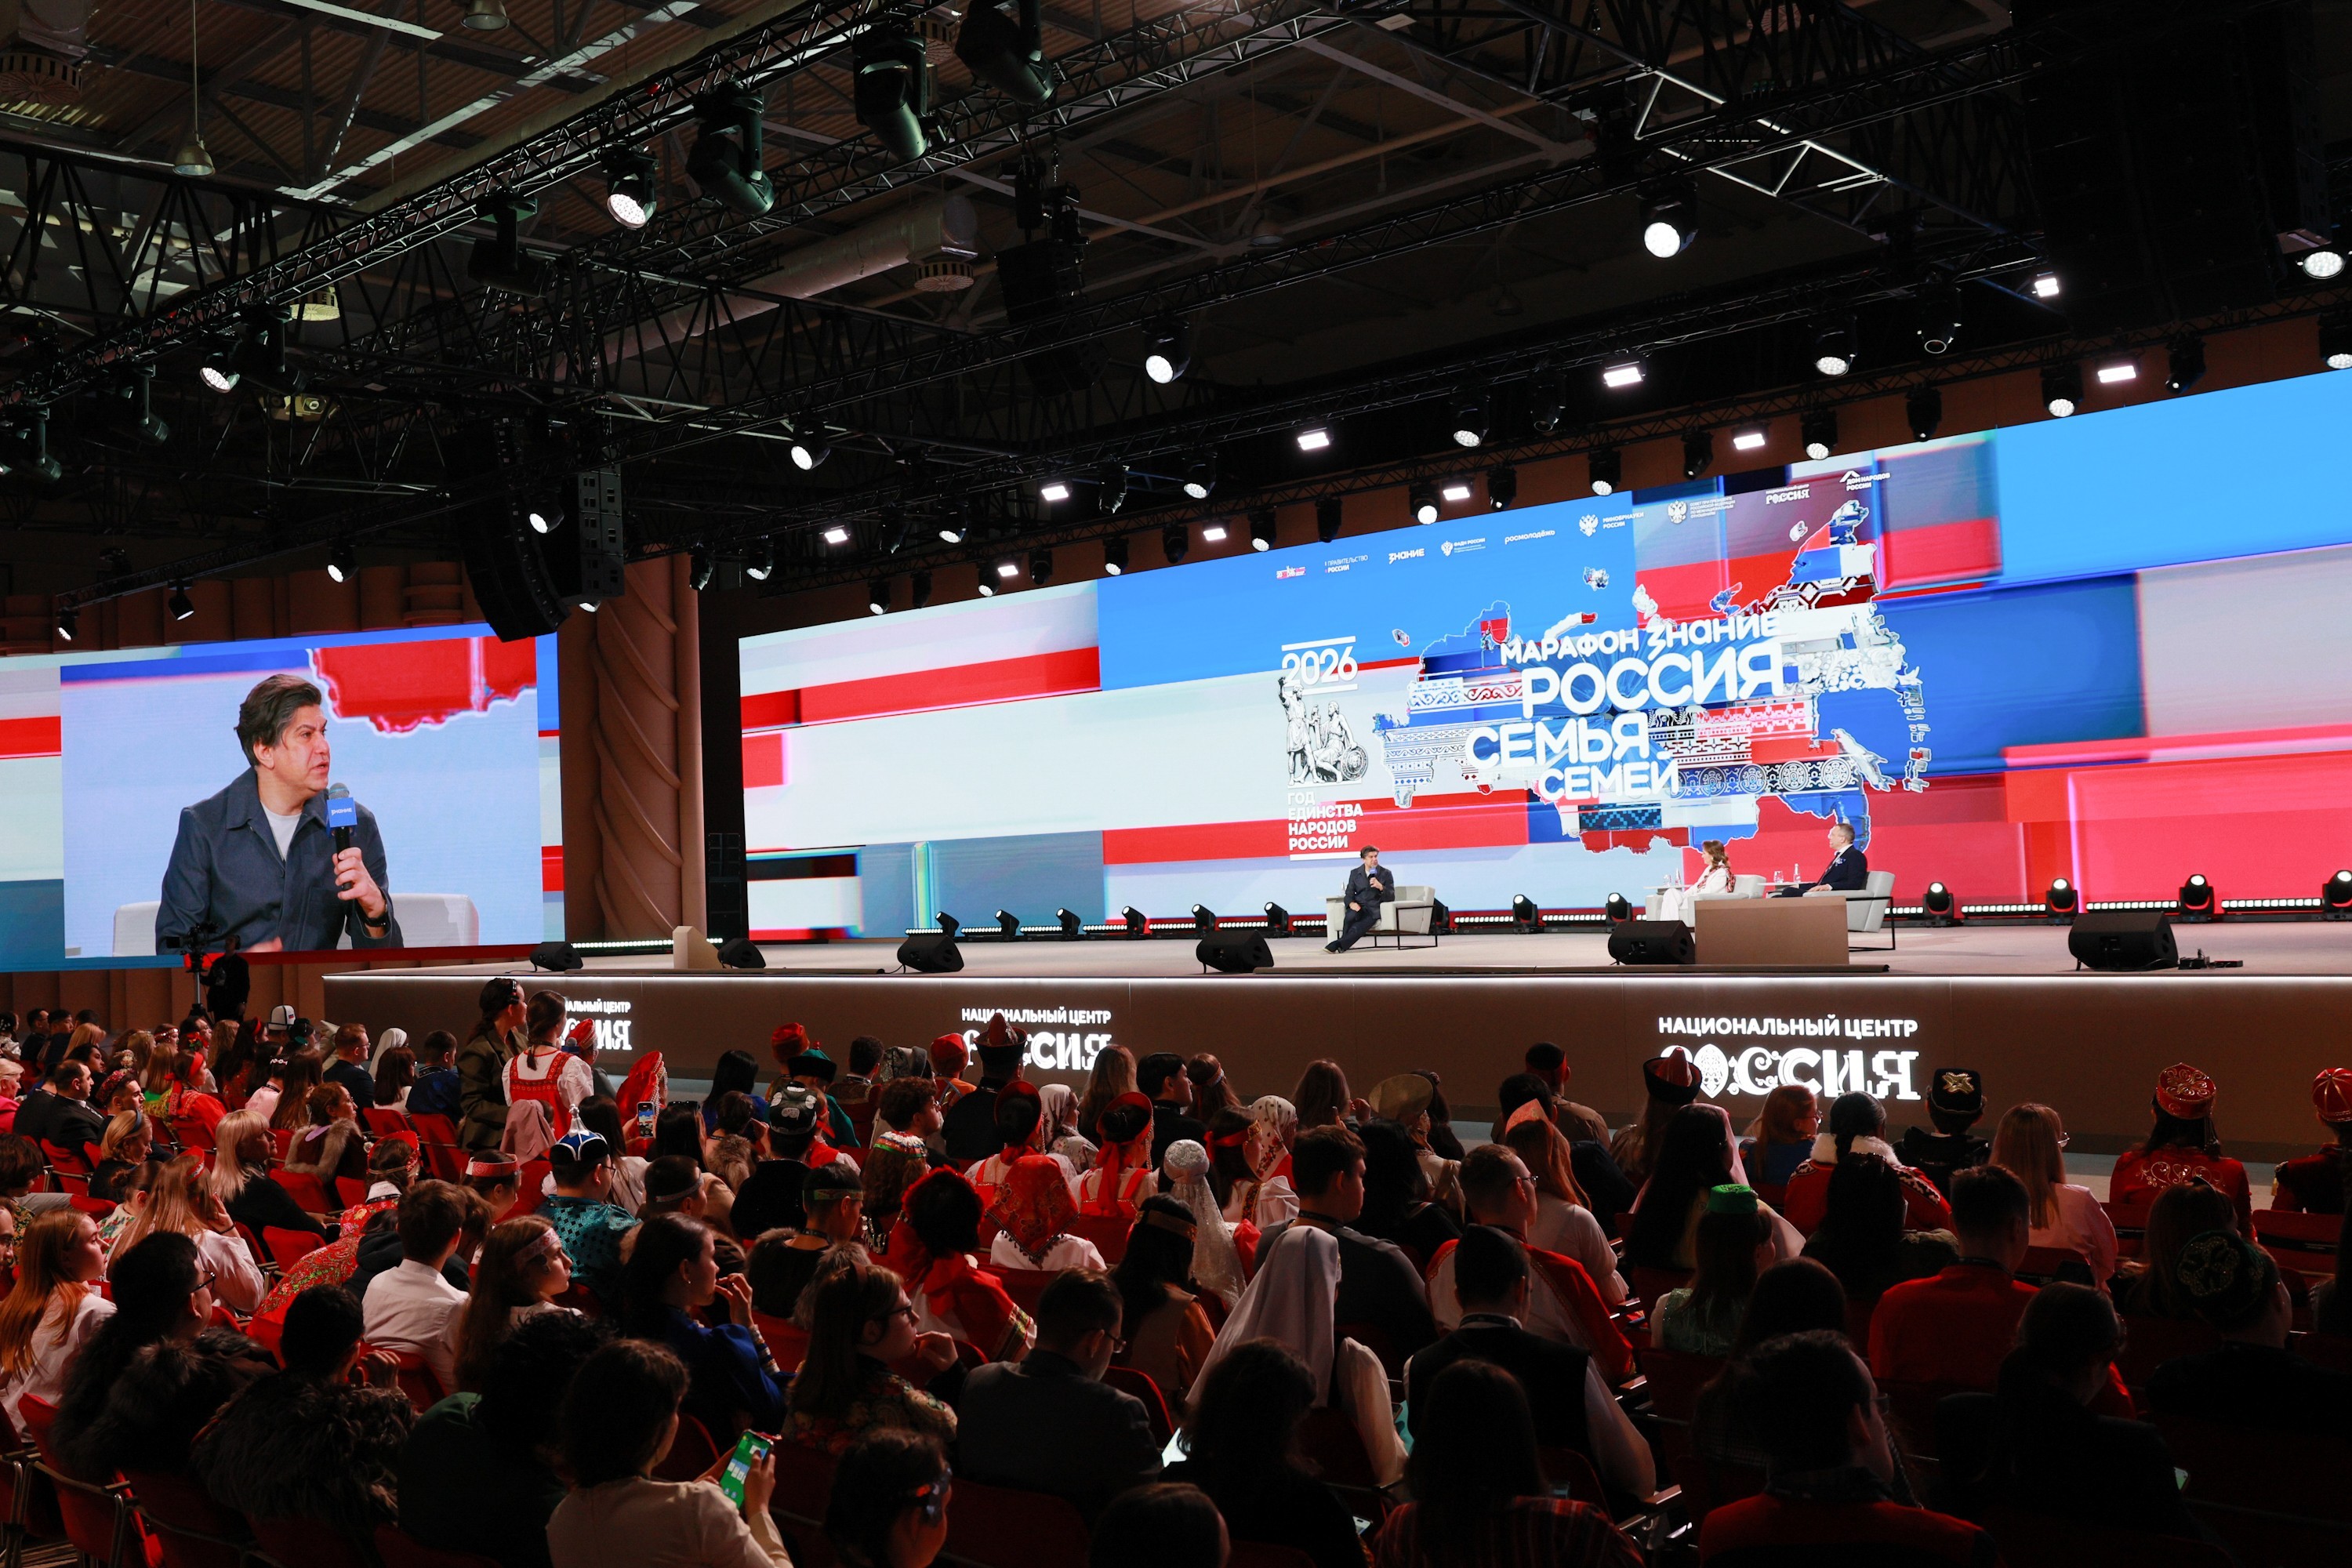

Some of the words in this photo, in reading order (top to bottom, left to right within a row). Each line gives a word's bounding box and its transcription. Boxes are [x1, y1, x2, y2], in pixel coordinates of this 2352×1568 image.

[1861, 472, 1890, 483] НАРОДОВ
[1846, 481, 1871, 492] РОССИИ
[1766, 488, 1809, 504] РОССИЯ
[1602, 512, 1644, 523] МИНОБРНАУКИ
[1327, 554, 1368, 566] ПРАВИТЕЛЬСТВО
[1327, 564, 1349, 573] РОССИИ
[1501, 628, 1639, 665] МАРАФОН
[1282, 646, 1358, 688] 2026
[1521, 641, 1784, 719] РОССИЯ
[1465, 711, 1649, 769] СЕМЬЯ
[1538, 750, 1679, 800] СЕМЕЙ
[1288, 791, 1315, 806] ГОД
[1288, 804, 1363, 822] ЕДИНСТВА
[1288, 819, 1357, 836] НАРОДОВ
[1289, 835, 1348, 851] РОССИИ
[603, 1001, 631, 1014] ЦЕНТР
[1069, 1010, 1112, 1025] ЦЕНТР
[1658, 1014, 1841, 1037] НАЦИОНАЛЬНЫЙ
[1844, 1018, 1918, 1040] ЦЕНТР
